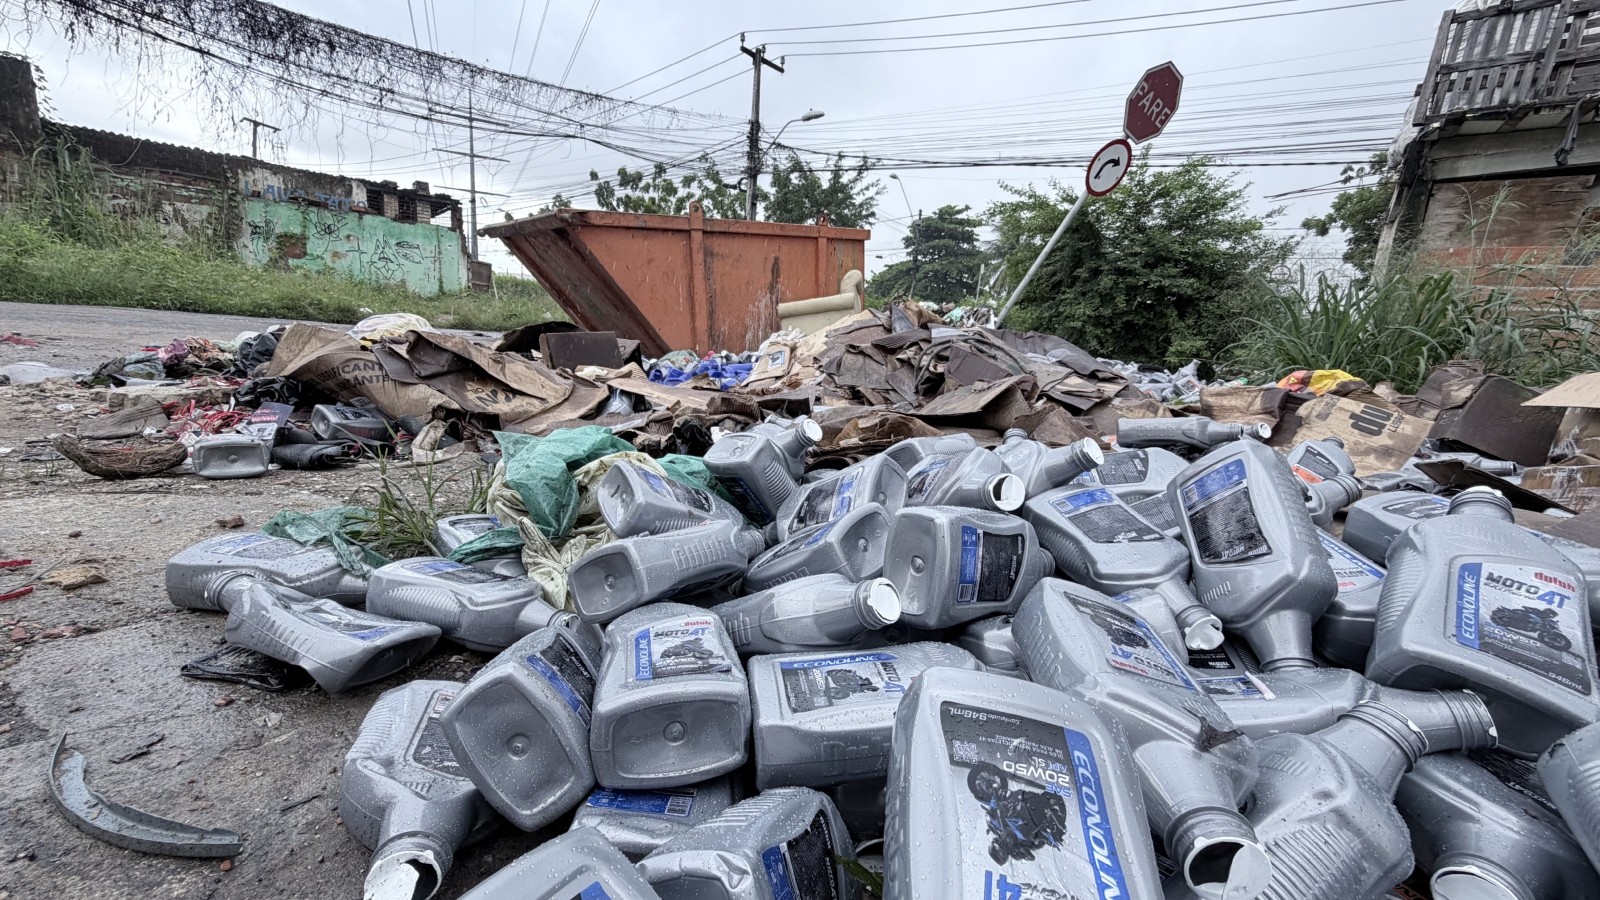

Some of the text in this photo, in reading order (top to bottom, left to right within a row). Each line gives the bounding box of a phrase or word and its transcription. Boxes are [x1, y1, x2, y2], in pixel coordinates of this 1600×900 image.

[1132, 80, 1171, 128] PARE
[1485, 572, 1571, 609] MOTO 4T
[1461, 572, 1477, 640] ECONOLINE
[653, 629, 689, 637] MOTO
[639, 638, 650, 675] ECONOLINE
[793, 655, 878, 668] ECONOLINE
[948, 707, 987, 720] 946mL
[1030, 756, 1045, 766] SL
[1001, 759, 1070, 786] 20W50
[1044, 782, 1073, 797] SAE
